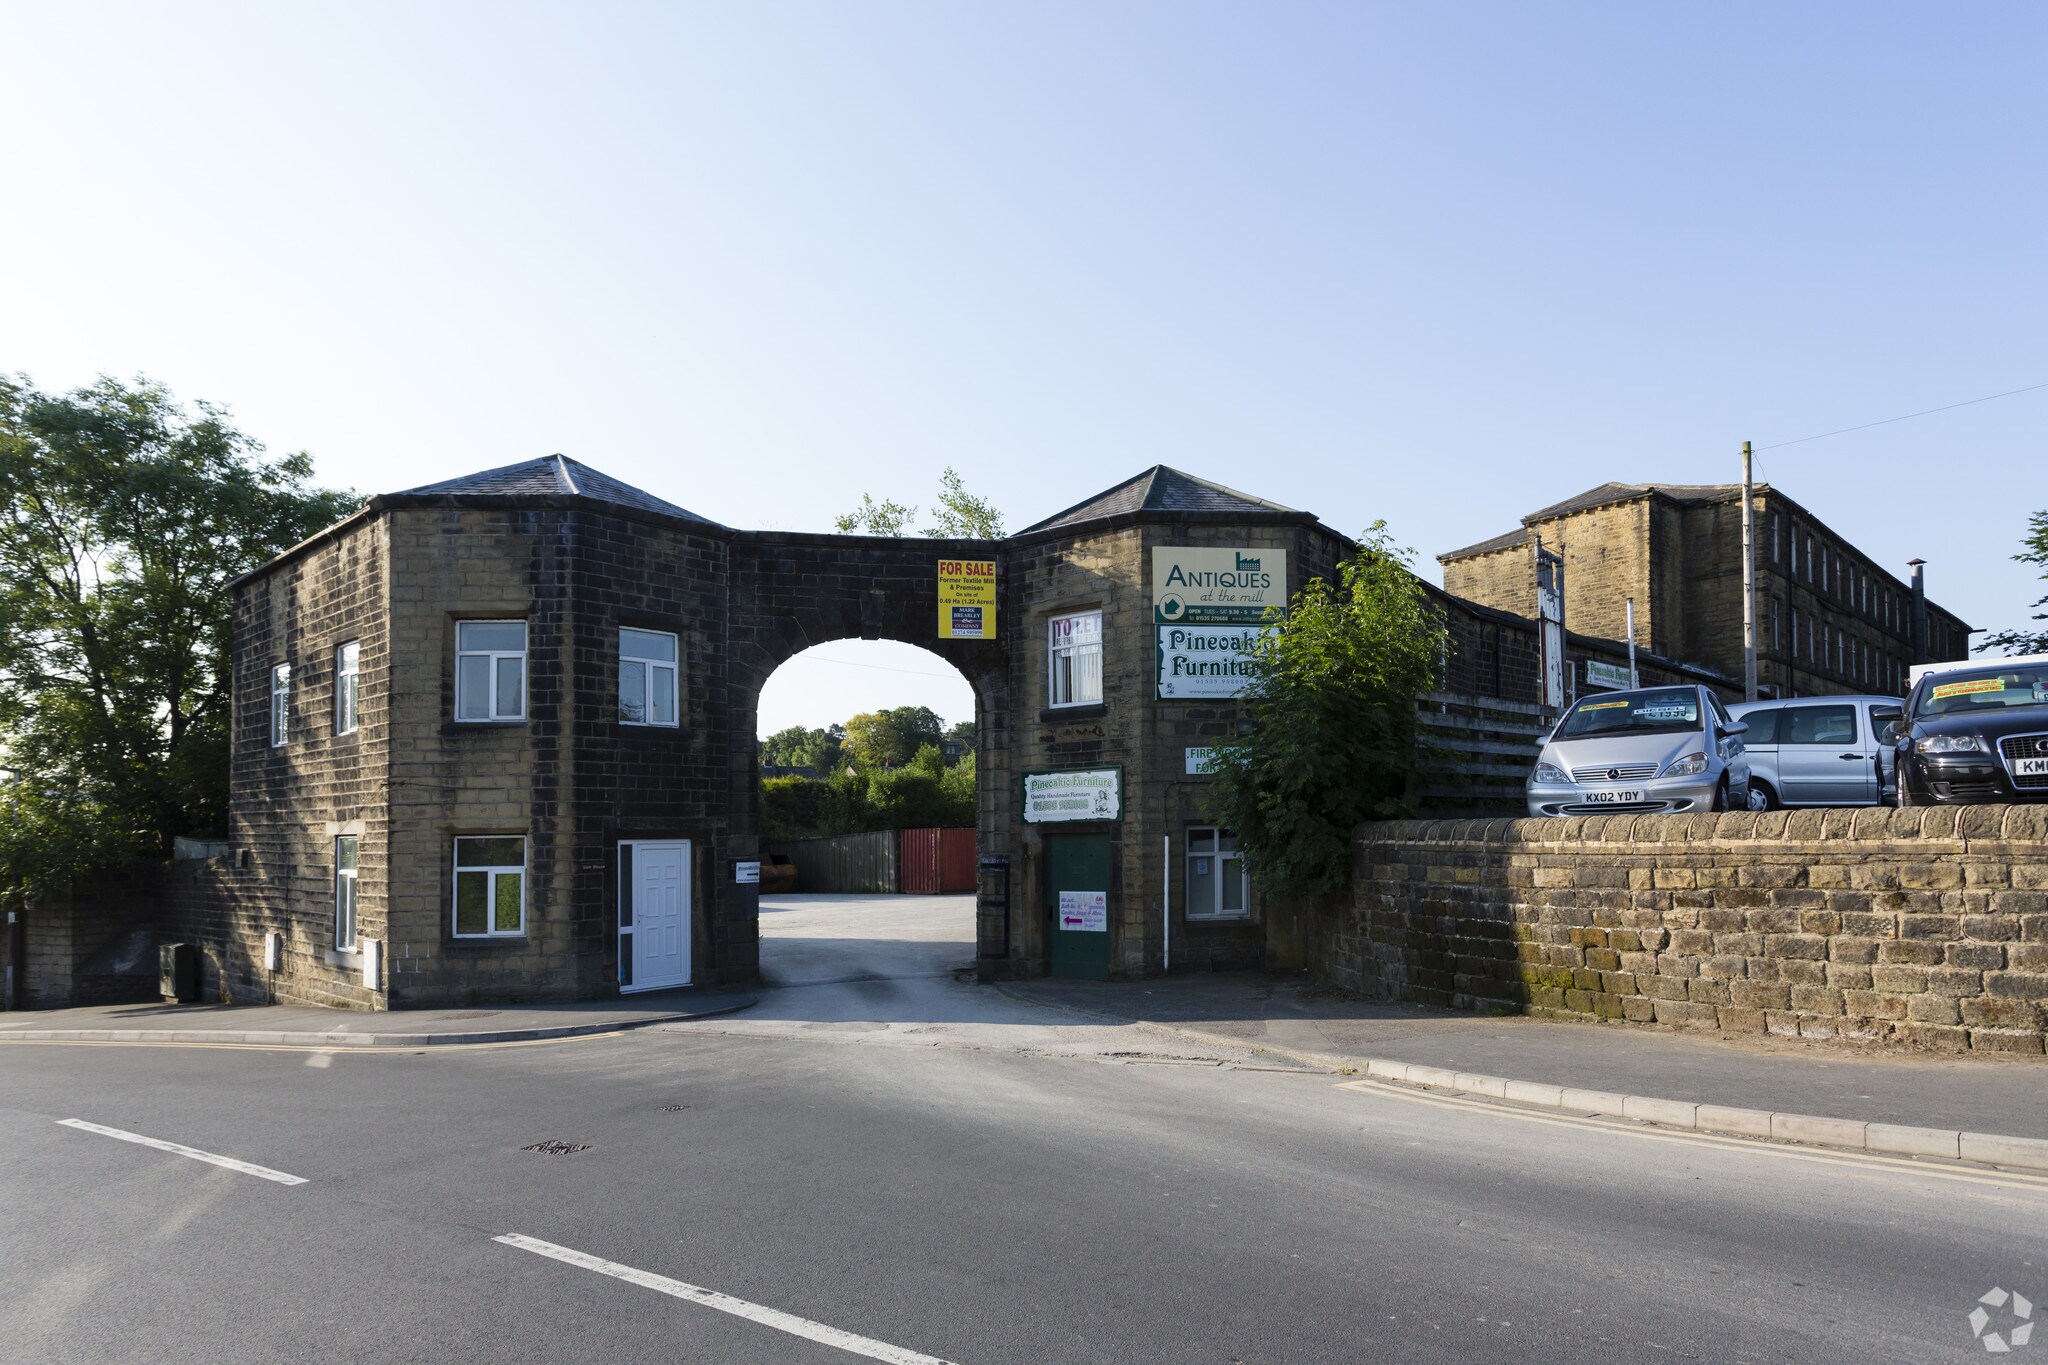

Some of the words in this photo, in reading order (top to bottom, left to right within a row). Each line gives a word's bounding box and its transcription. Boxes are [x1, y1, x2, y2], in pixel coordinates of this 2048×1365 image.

[940, 562, 962, 575] FOR
[966, 563, 994, 576] SALE
[1165, 564, 1270, 588] ANTIQUES
[1200, 589, 1214, 602] at
[1218, 590, 1236, 602] the
[1240, 590, 1264, 602] mill
[1056, 619, 1072, 637] TO
[1171, 655, 1266, 676] Furnitur
[1190, 749, 1212, 758] FIRE
[1072, 774, 1113, 788] Furniture
[1586, 792, 1614, 802] KX02
[1617, 791, 1639, 801] YDY
